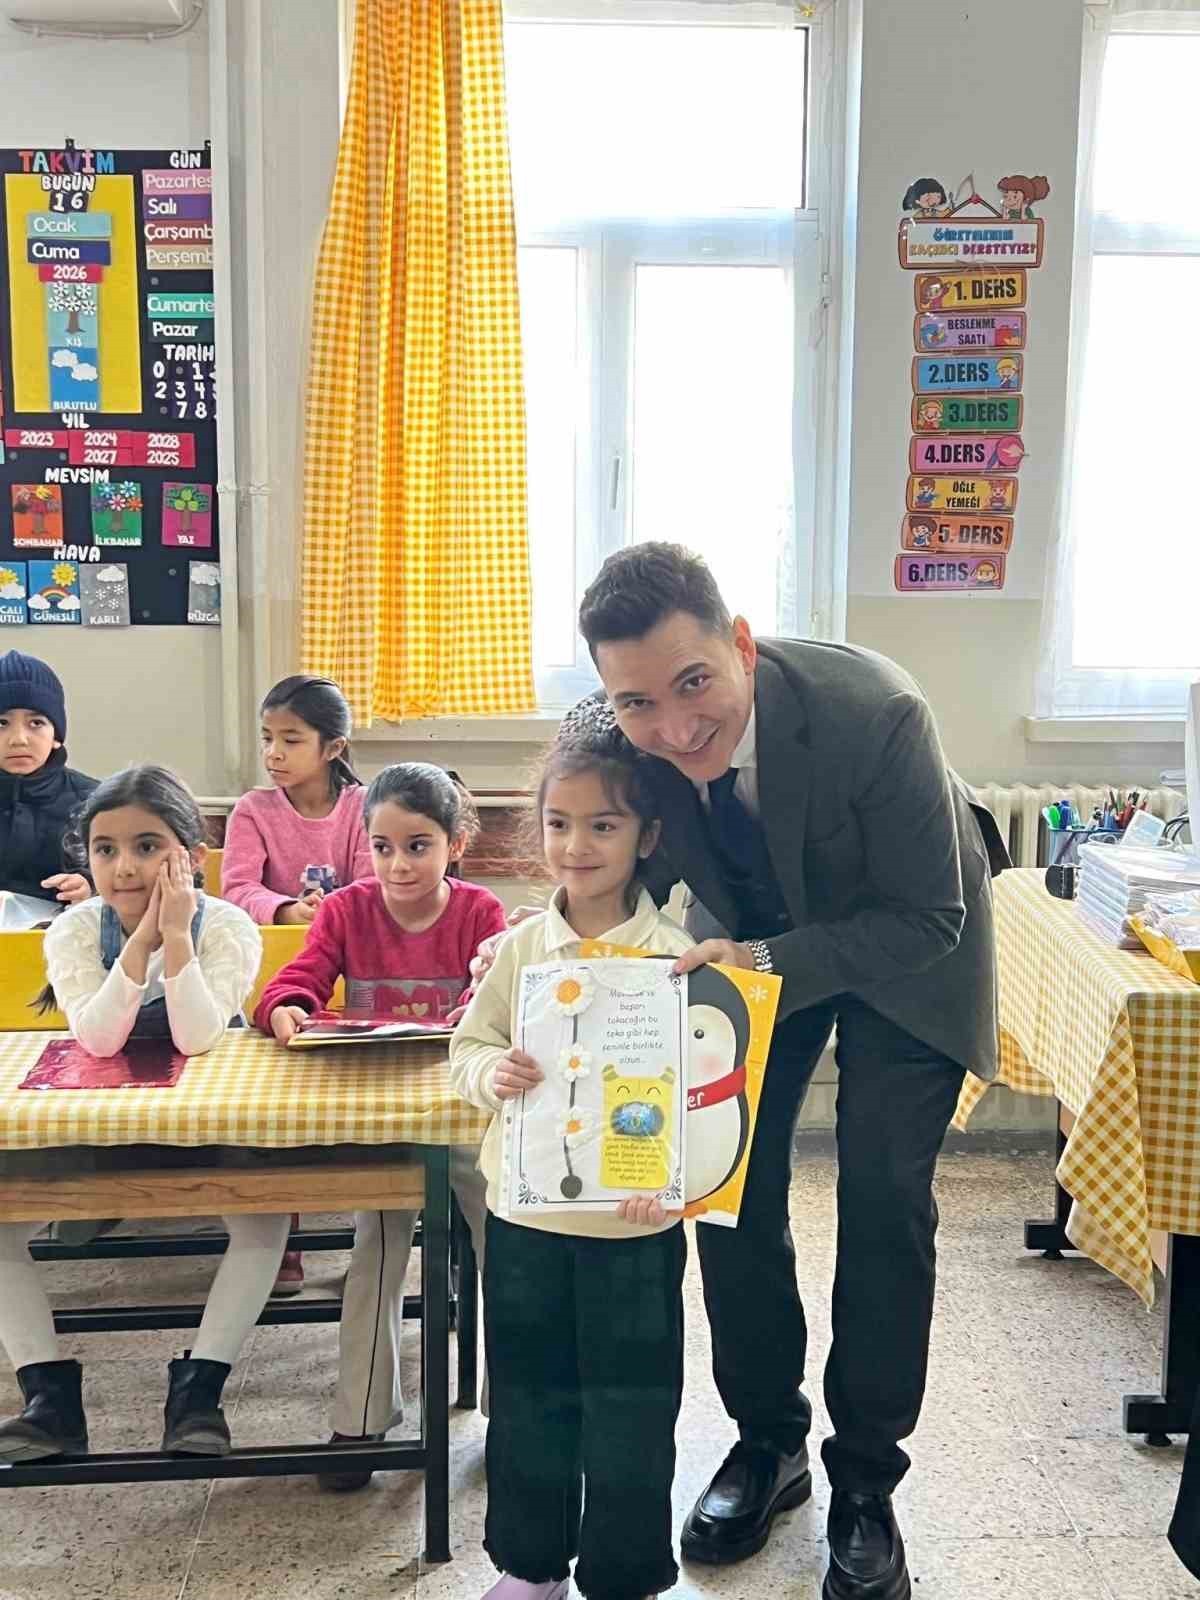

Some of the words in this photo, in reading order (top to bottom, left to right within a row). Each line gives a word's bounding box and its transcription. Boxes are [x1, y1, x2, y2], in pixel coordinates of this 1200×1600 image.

[18, 150, 115, 174] TAKVİM
[169, 150, 201, 169] GÜN
[41, 173, 96, 192] BUGÜN
[148, 198, 177, 215] Salı
[33, 216, 78, 234] Ocak
[31, 242, 80, 260] Cuma
[53, 265, 88, 280] 2026
[954, 281, 967, 300] 1.
[971, 278, 1017, 300] DERS
[152, 321, 199, 337] Pazar
[947, 318, 996, 331] BESLENME
[153, 360, 165, 379] 0
[192, 362, 204, 380] 1
[928, 363, 989, 384] 2.DERS
[154, 381, 167, 399] 2
[174, 381, 186, 399] 3
[194, 381, 206, 399] 4
[176, 401, 188, 419] 7
[195, 401, 208, 419] 8
[949, 403, 1009, 422] 3.DERS
[62, 412, 90, 429] YIL
[20, 431, 54, 447] 2023
[84, 432, 118, 447] 2024
[147, 433, 180, 449] 2028
[84, 449, 117, 464] 2027
[147, 450, 180, 465] 2025
[924, 444, 985, 463] 4.DERS
[45, 466, 110, 484] MEVSİM
[176, 535, 195, 546] YAZ
[938, 524, 954, 544] 5.
[958, 525, 1003, 545] DERS
[53, 545, 101, 562] HAVA
